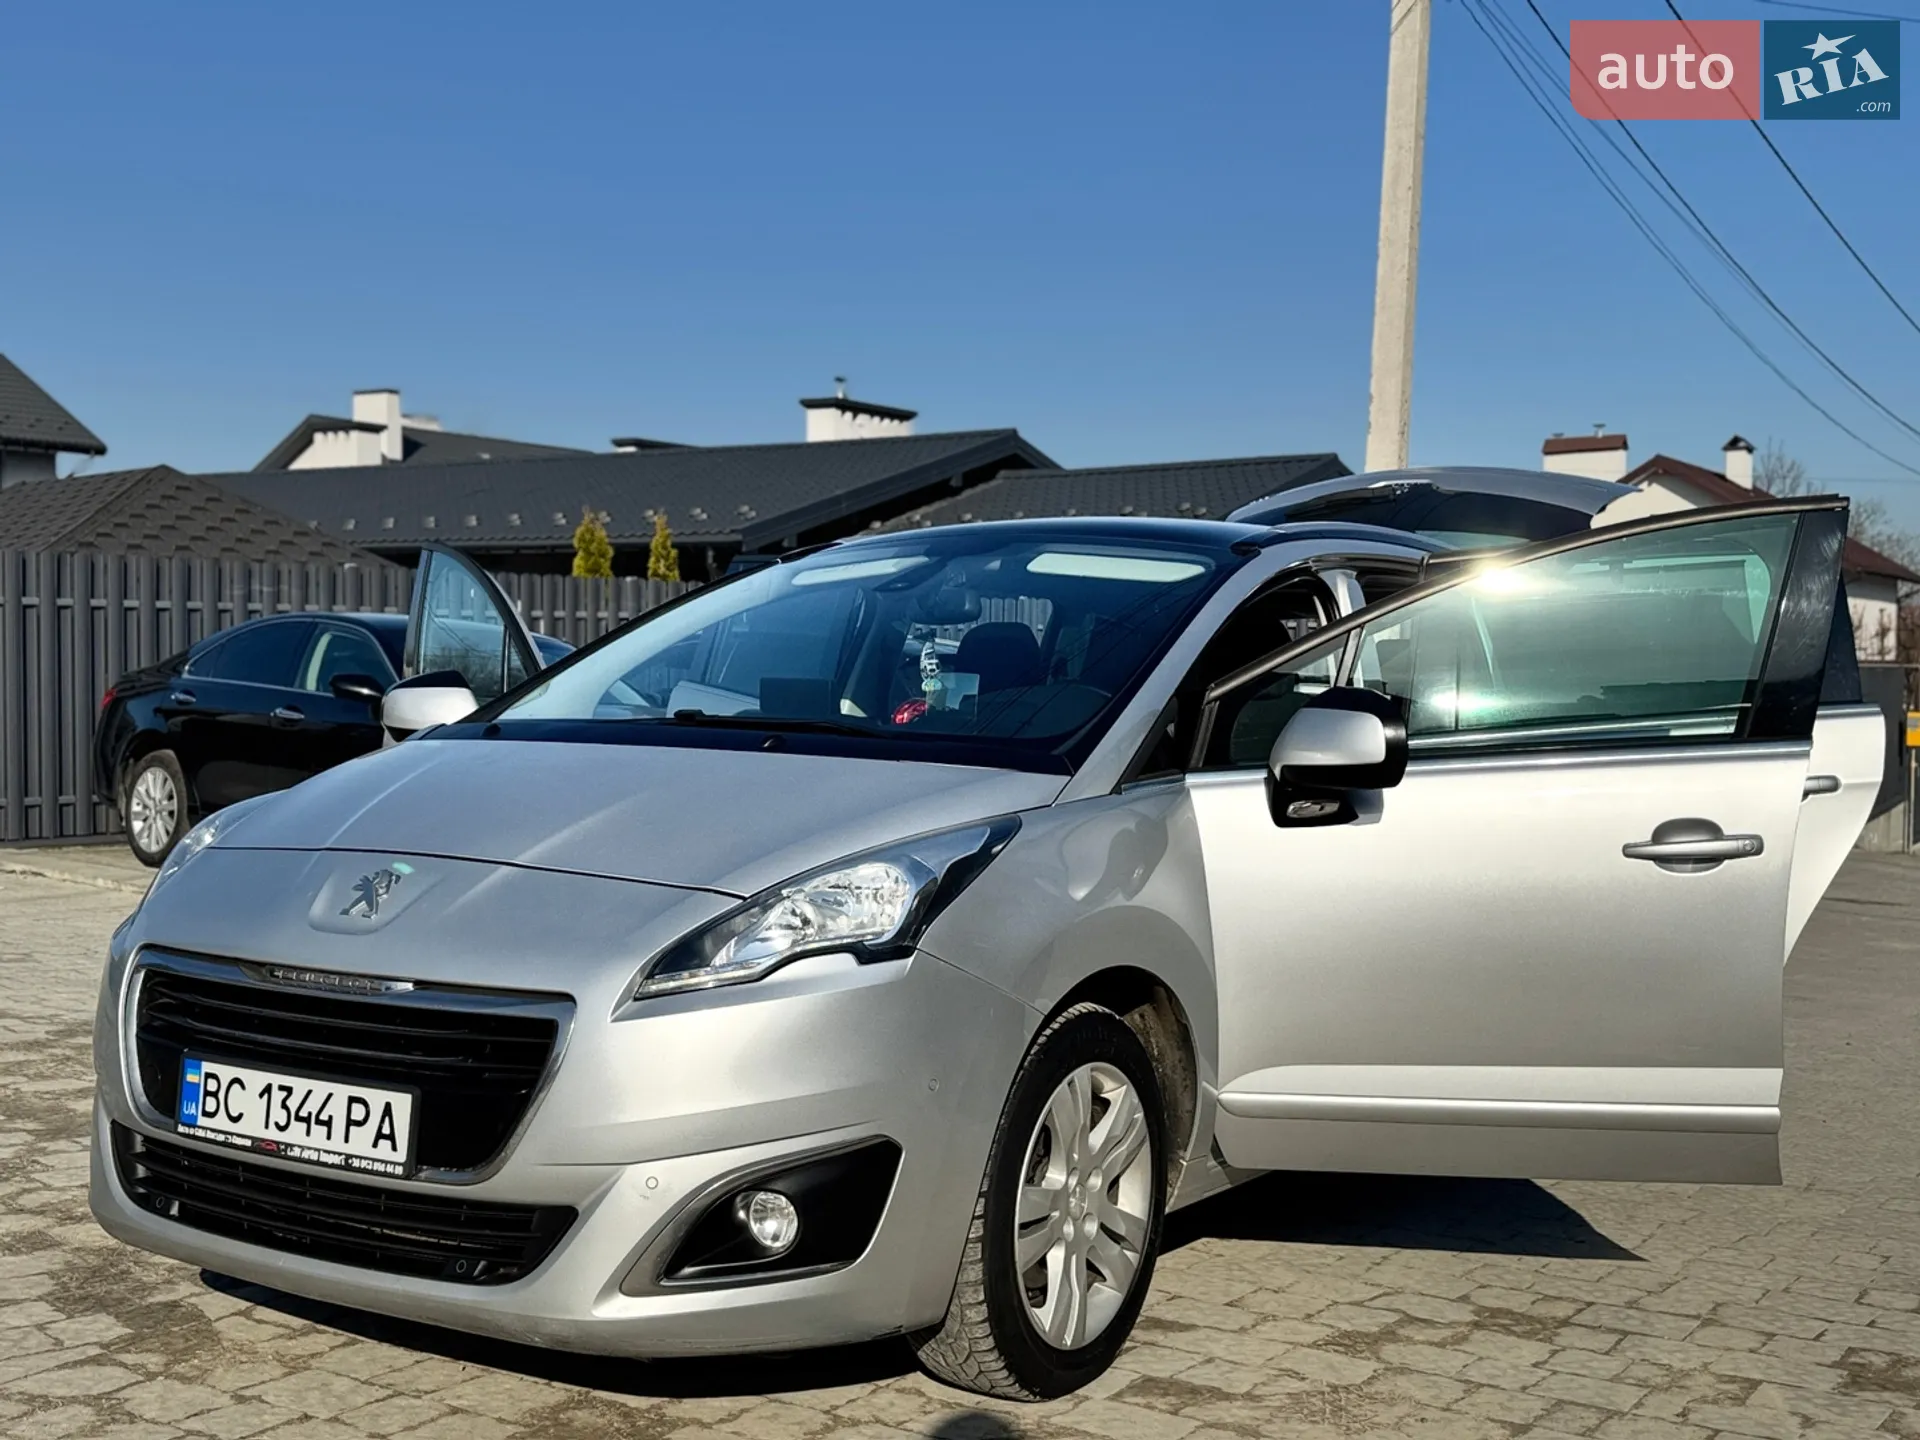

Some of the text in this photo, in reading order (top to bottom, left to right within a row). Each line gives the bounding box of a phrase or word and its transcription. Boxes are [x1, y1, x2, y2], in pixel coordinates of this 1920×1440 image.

[183, 1099, 197, 1116] UA
[201, 1071, 247, 1124] BC
[257, 1081, 335, 1141] 1344
[343, 1094, 399, 1153] PA
